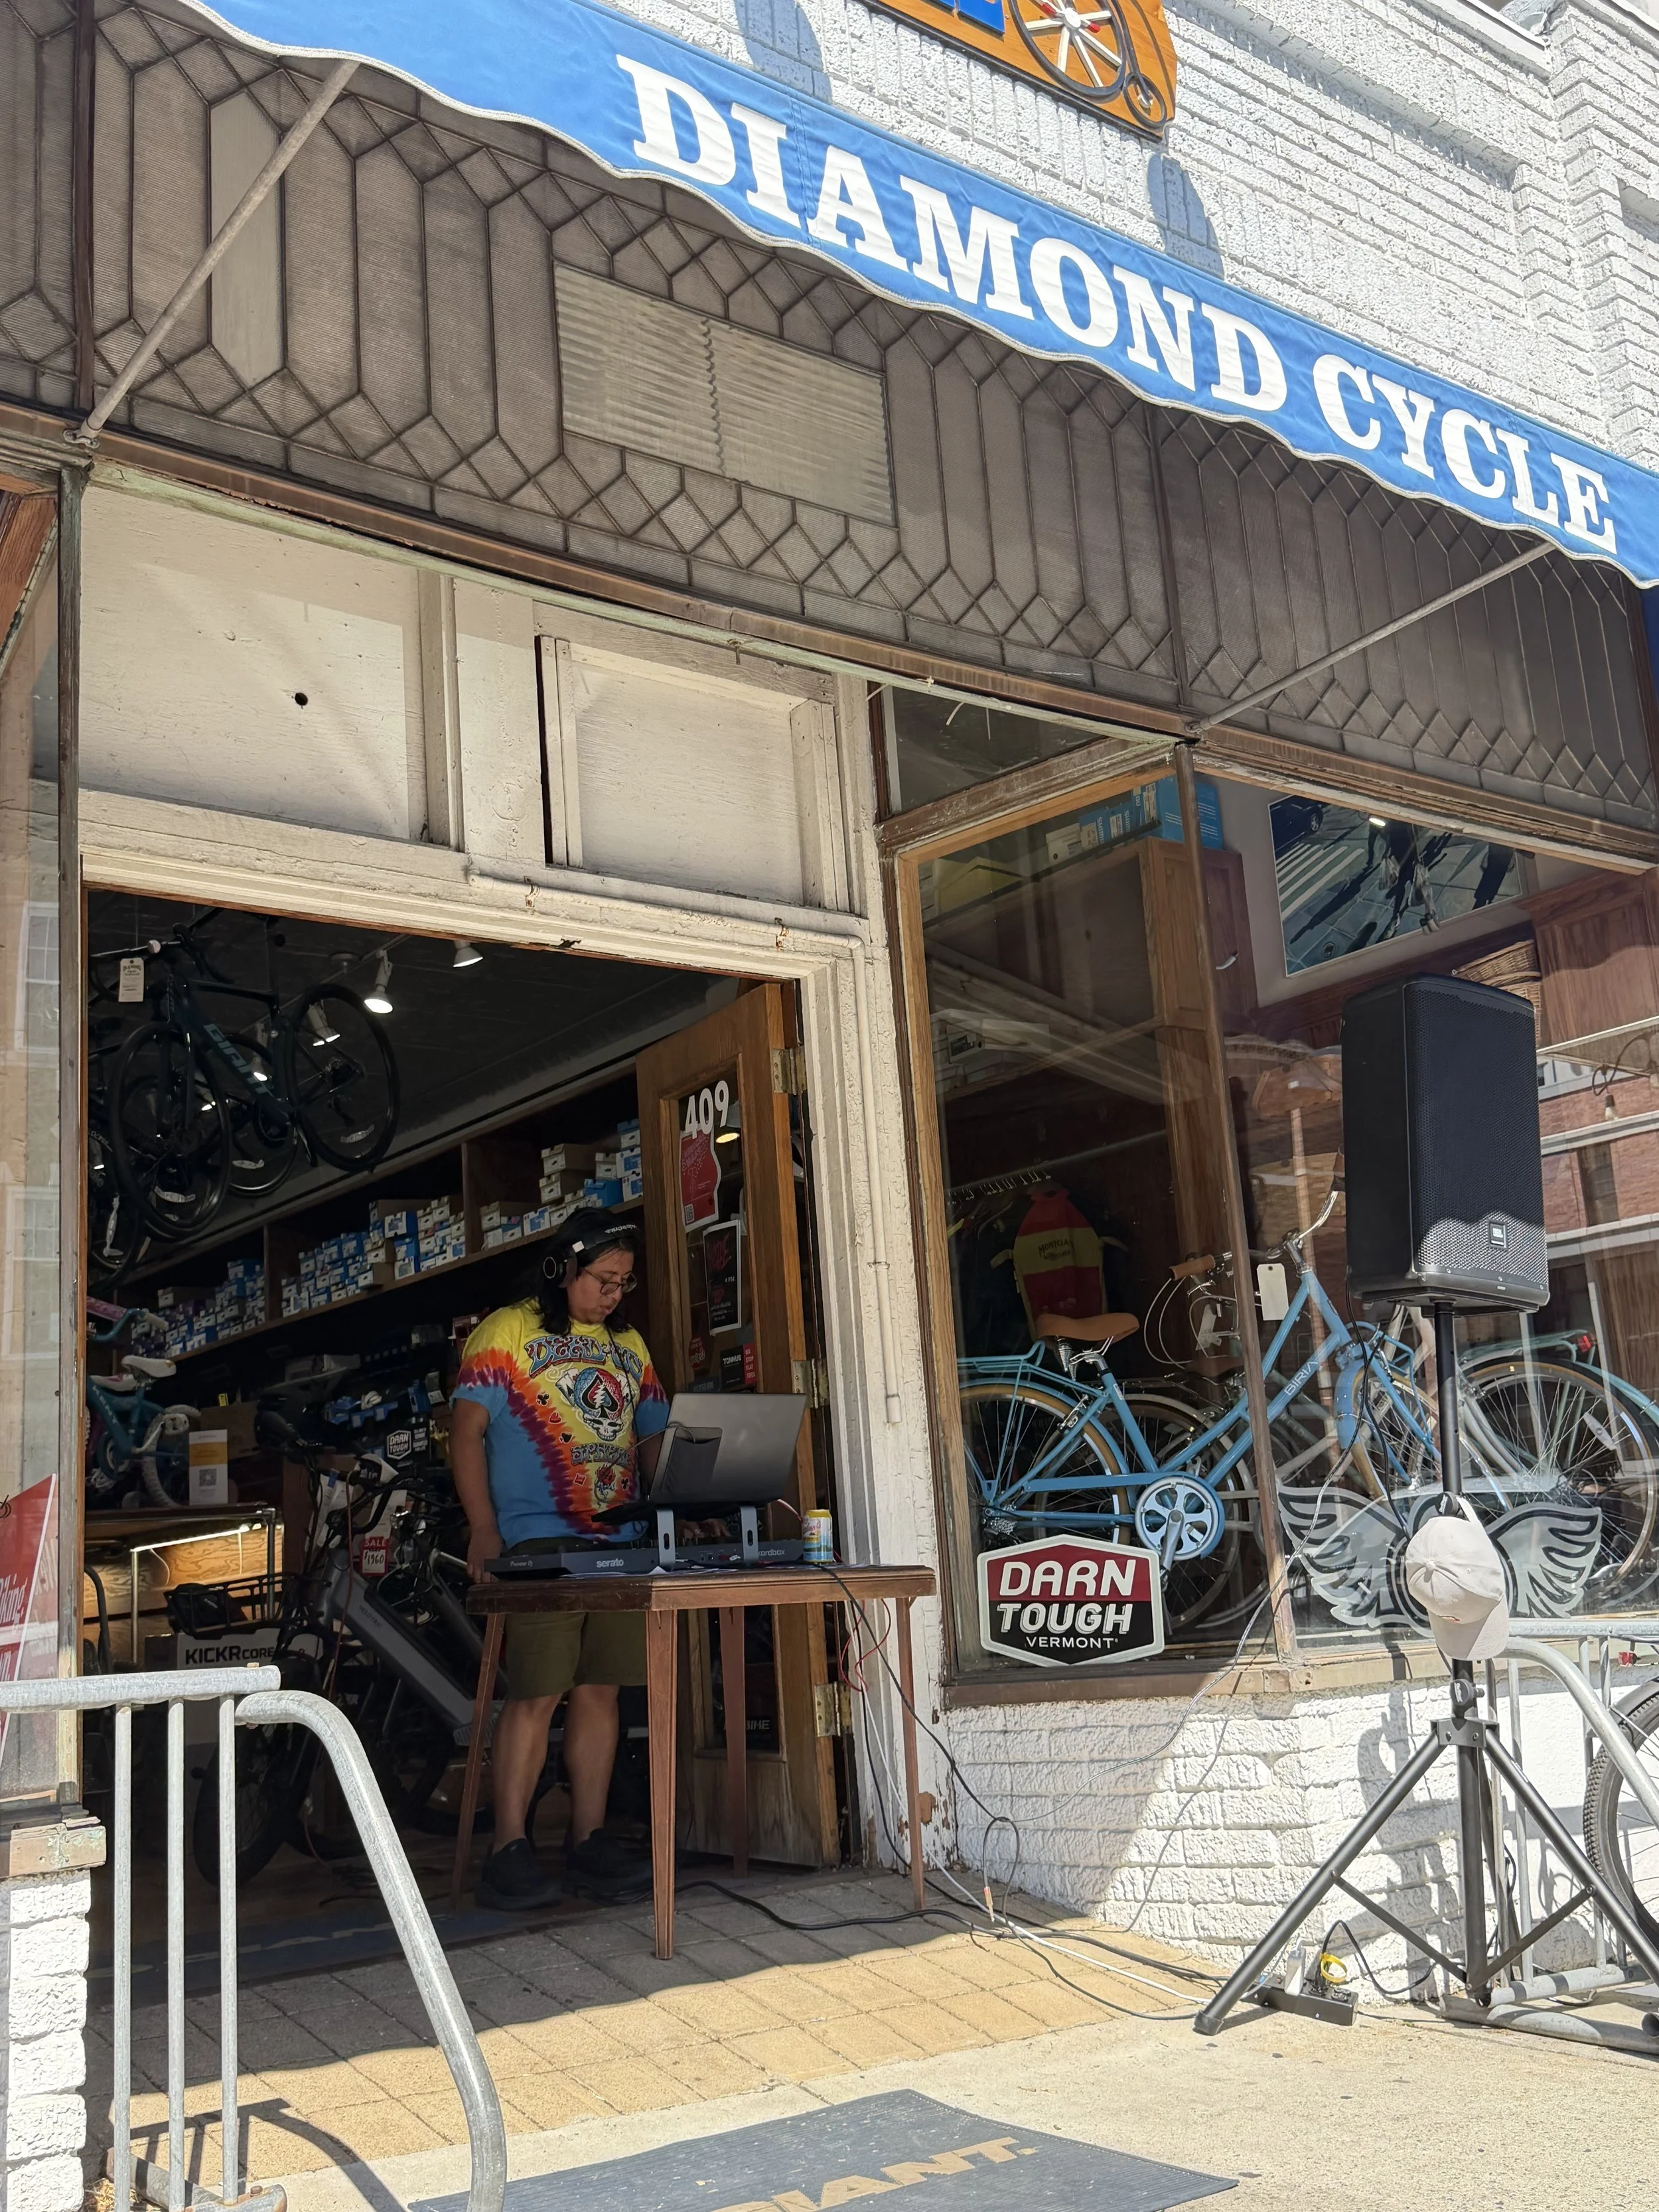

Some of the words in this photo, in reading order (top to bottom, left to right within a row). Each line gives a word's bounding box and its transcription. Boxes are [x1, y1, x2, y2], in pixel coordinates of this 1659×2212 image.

[614, 53, 1289, 412] DIAMOND
[1314, 352, 1618, 555] CYCLE
[685, 1080, 729, 1140] 409
[524, 1335, 607, 1379] DEAD
[1284, 1361, 1318, 1395] BIRIA
[390, 1433, 409, 1445] DARN
[390, 1443, 409, 1453] TOUGH
[596, 1558, 624, 1568] serato
[999, 1559, 1136, 1596] DARN
[997, 1602, 1133, 1635] TOUGH
[185, 1645, 241, 1664] KICKR
[242, 1647, 275, 1660] CORE
